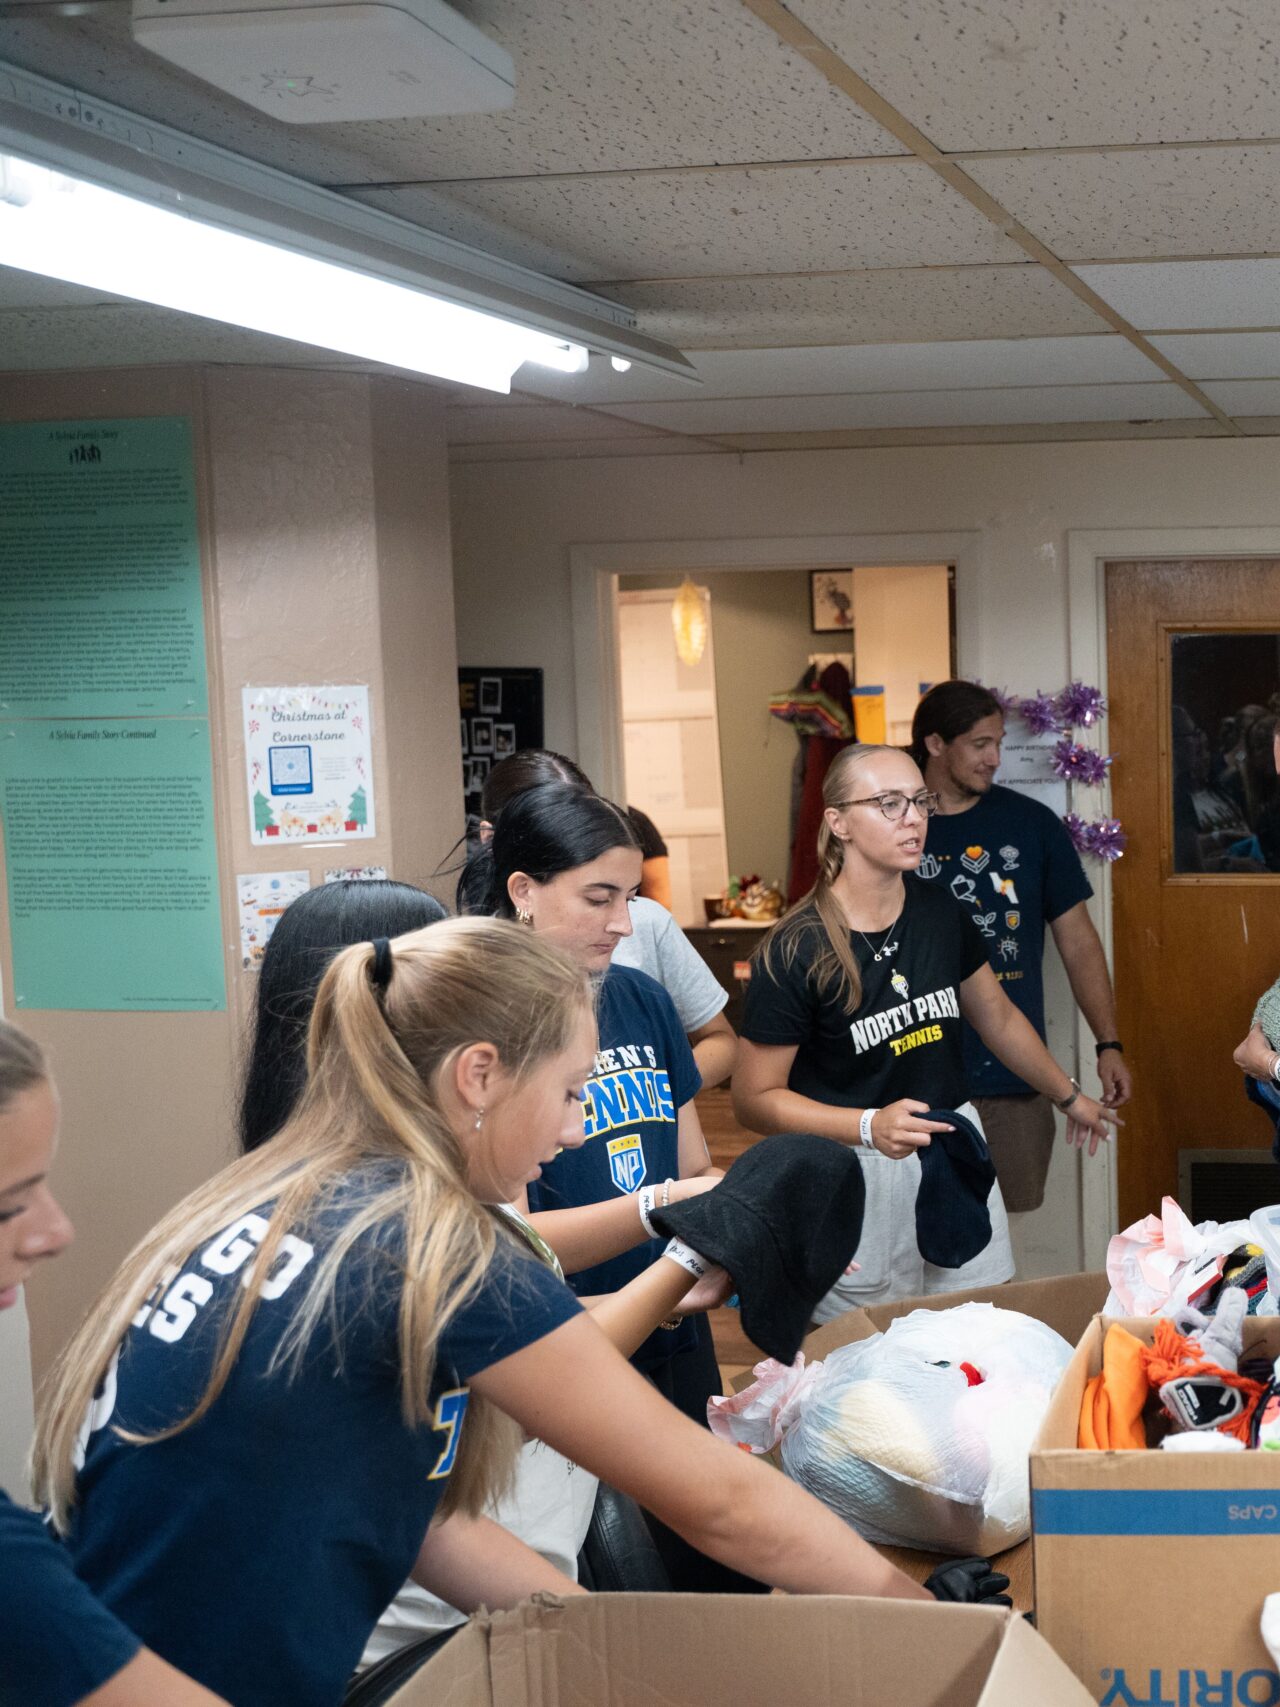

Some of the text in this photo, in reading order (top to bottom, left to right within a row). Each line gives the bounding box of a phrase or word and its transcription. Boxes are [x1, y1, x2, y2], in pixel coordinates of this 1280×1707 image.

[271, 709, 347, 723] Christmas at
[77, 730, 100, 741] Family
[101, 730, 120, 740] Story
[121, 729, 157, 740] Continued
[272, 731, 345, 743] Cornerstone
[849, 986, 960, 1055] NORTH PARK
[889, 1023, 943, 1057] TENNIS
[613, 1150, 641, 1190] NP
[1227, 1503, 1278, 1520] CAPS
